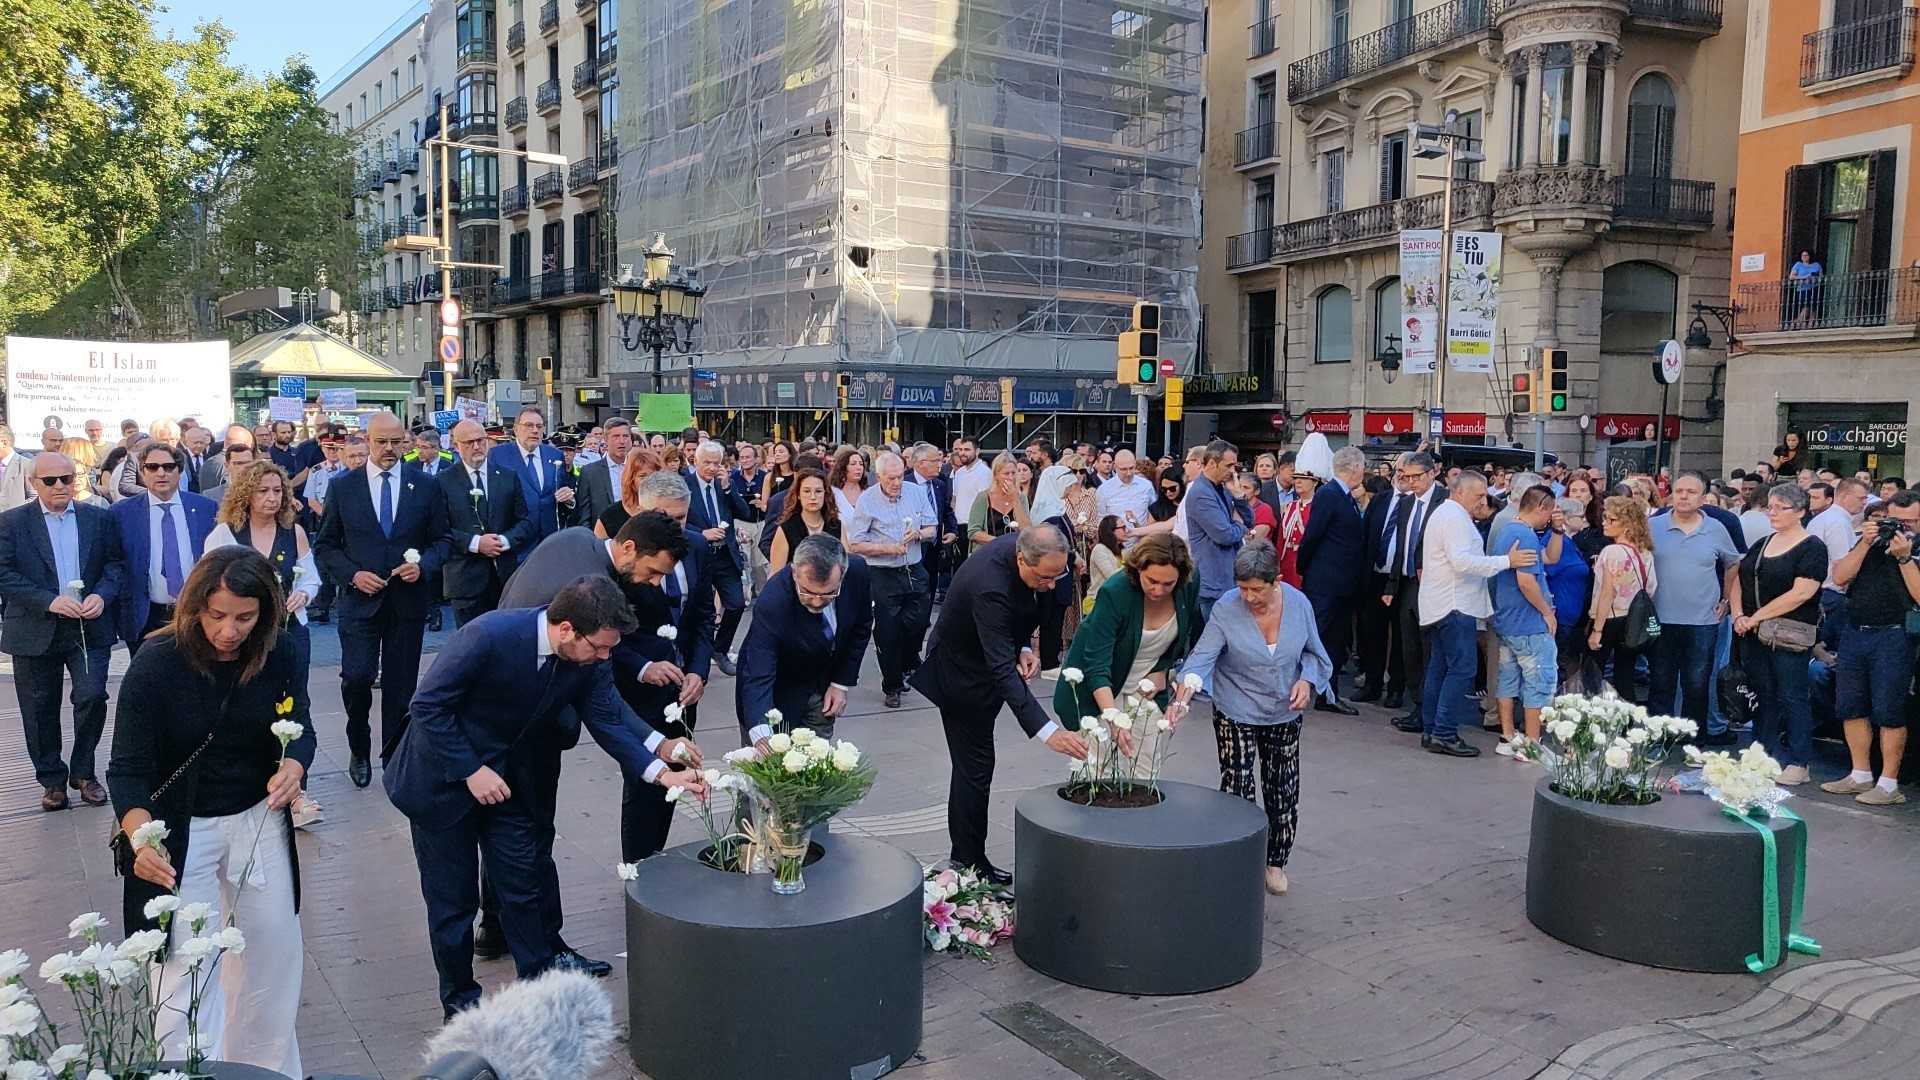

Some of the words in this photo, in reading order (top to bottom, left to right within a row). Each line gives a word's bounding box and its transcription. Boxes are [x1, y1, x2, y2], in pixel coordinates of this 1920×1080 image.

[1402, 241, 1424, 250] SANT
[1455, 236, 1464, 253] hola
[1465, 236, 1480, 250] ES
[1464, 251, 1484, 265] TIU
[1450, 328, 1469, 337] Barri
[89, 351, 104, 368] El
[112, 352, 157, 370] Islam
[15, 370, 49, 380] condena
[1224, 376, 1259, 391] PARIS
[900, 387, 935, 402] BBVA
[1029, 391, 1060, 404] BBVA
[1446, 420, 1486, 433] Santande
